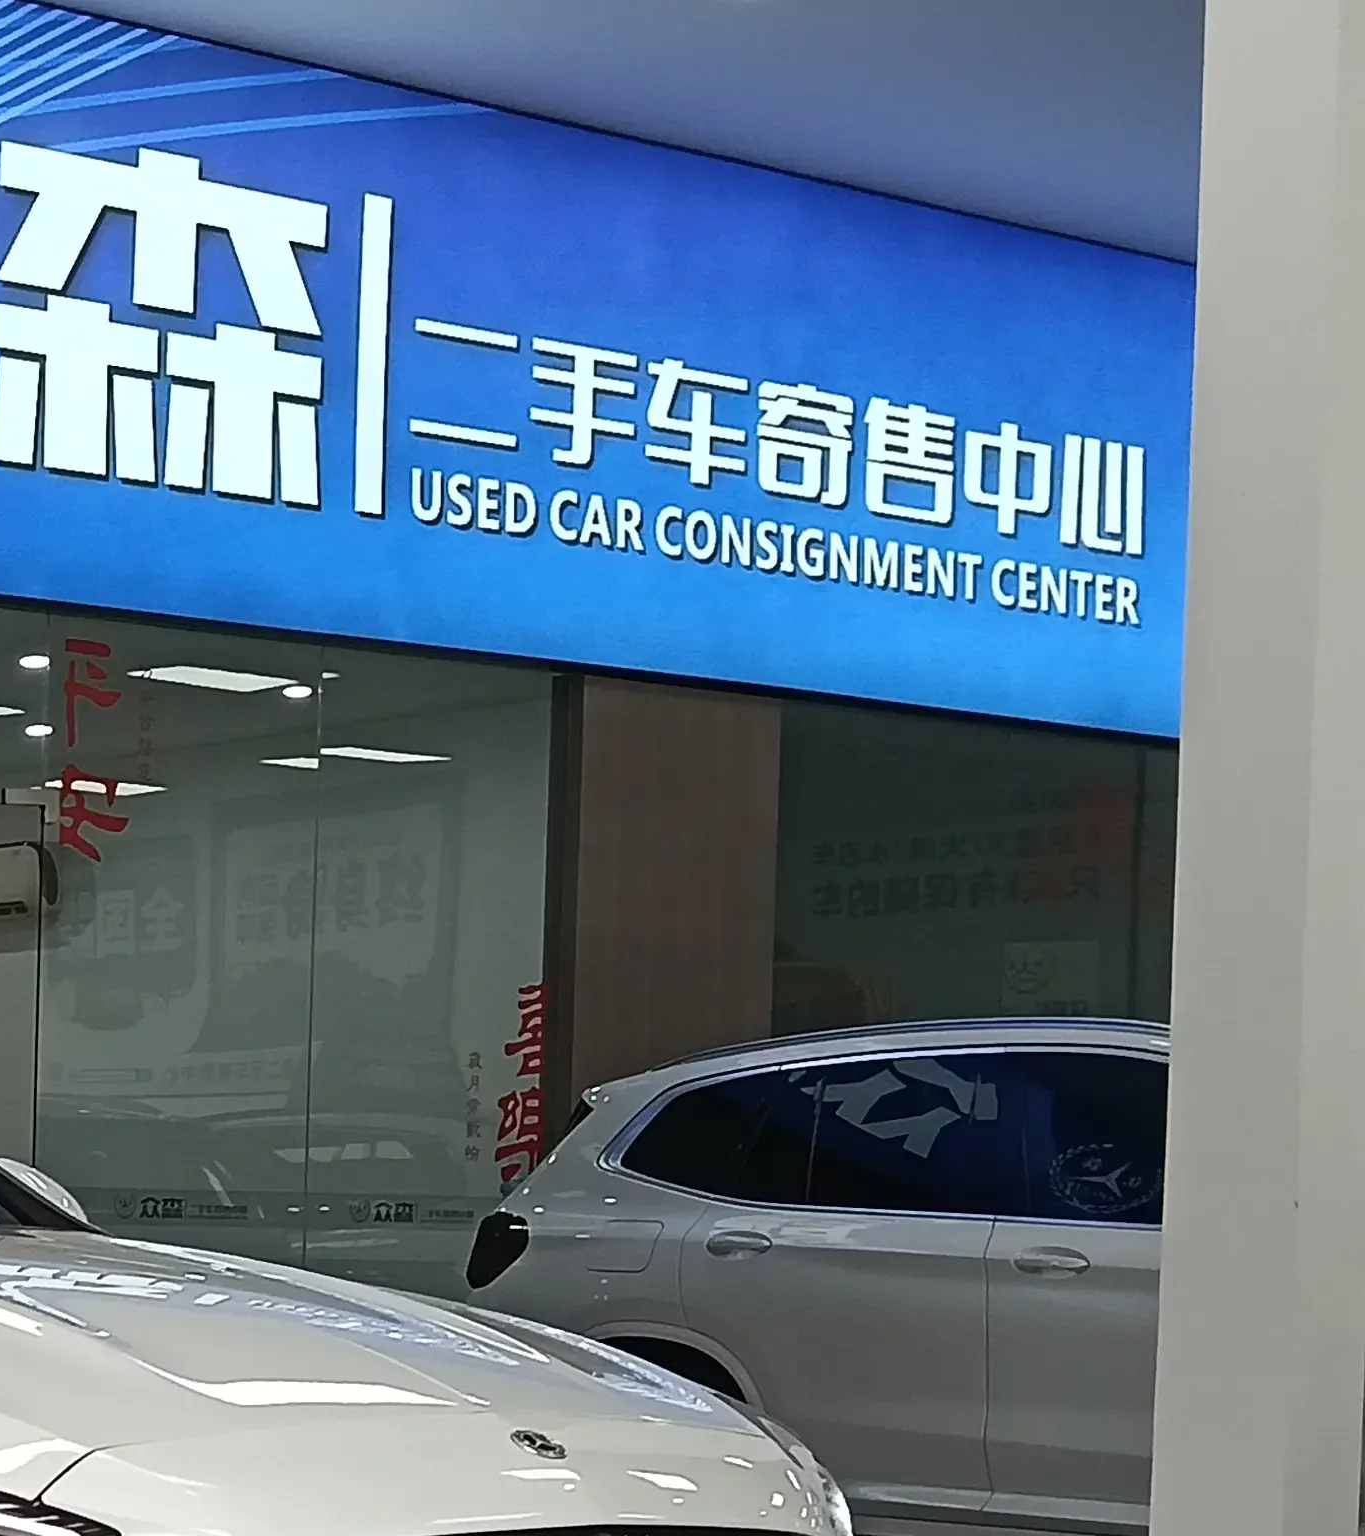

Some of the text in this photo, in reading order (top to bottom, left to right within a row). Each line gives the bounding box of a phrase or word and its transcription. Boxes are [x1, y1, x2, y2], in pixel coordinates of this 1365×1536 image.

[409, 318, 1145, 556] 二手车寄售中心
[410, 467, 1140, 626] USED CAR CONSIGNMENT CENTER
